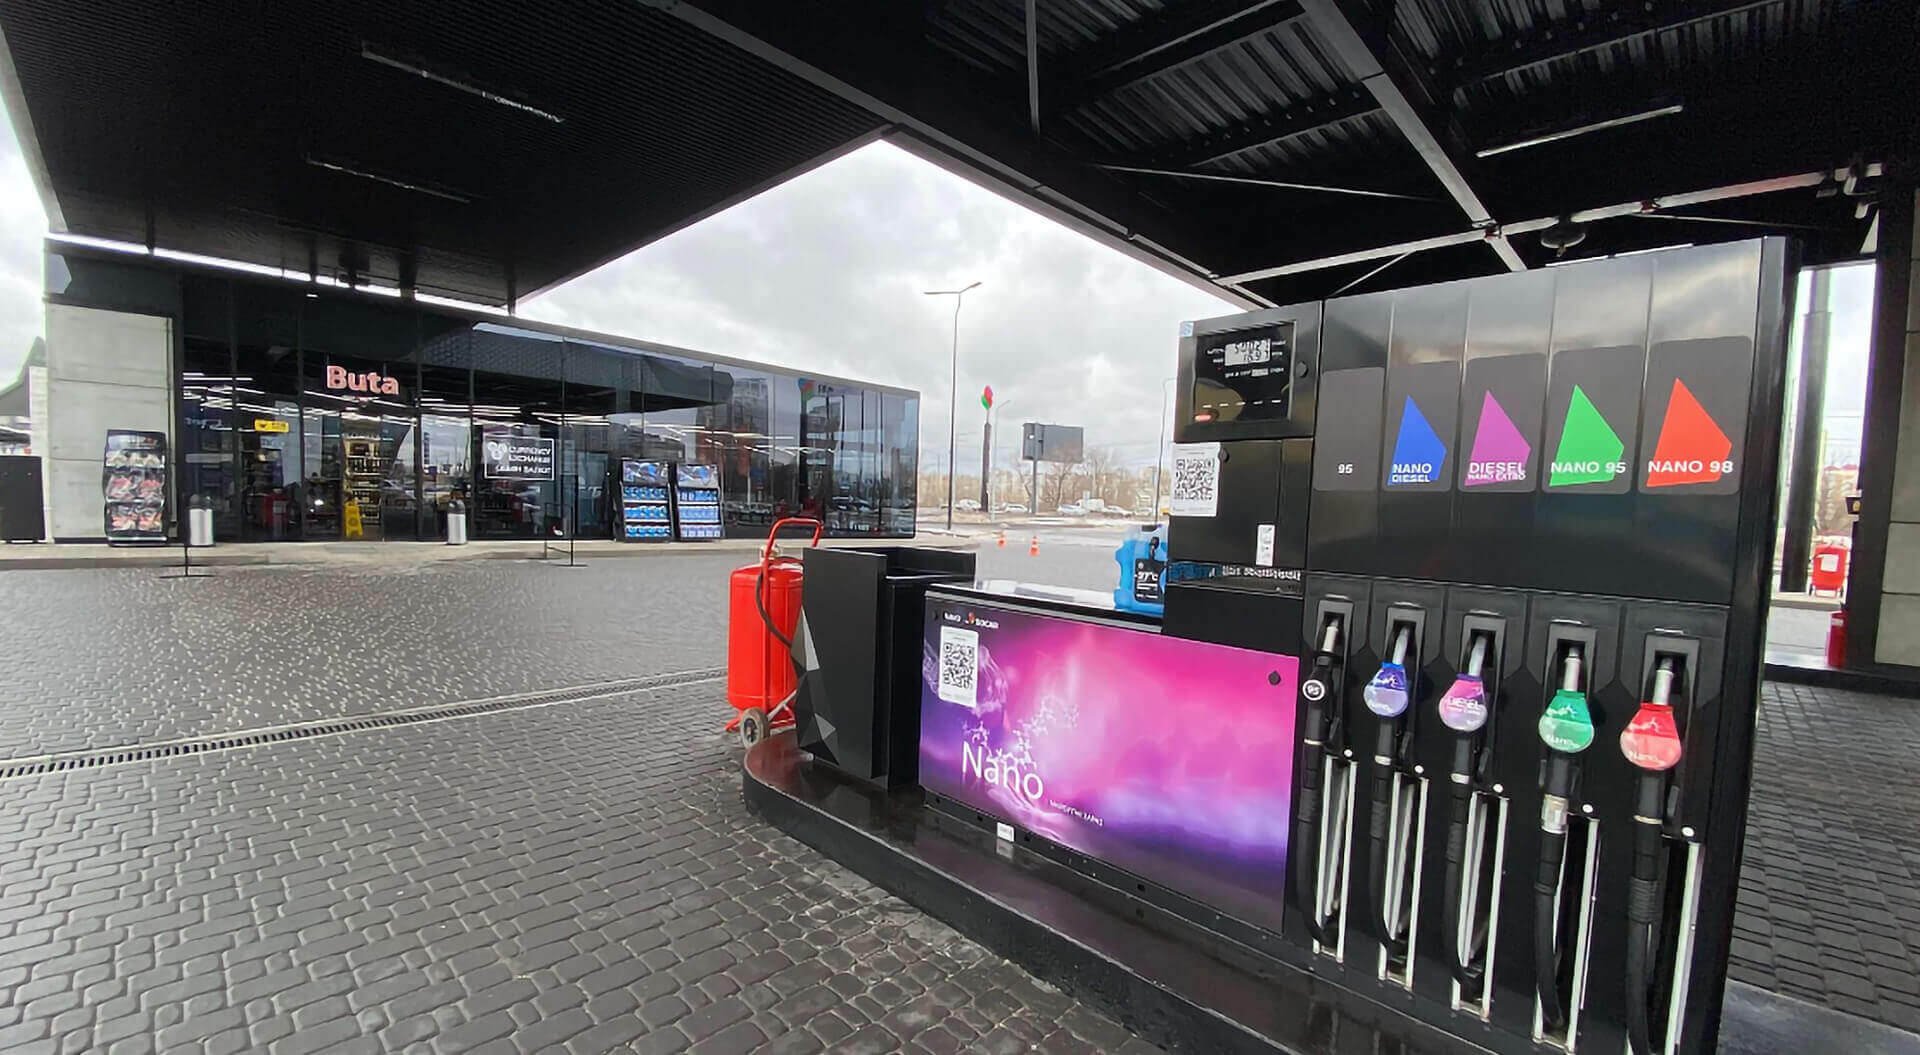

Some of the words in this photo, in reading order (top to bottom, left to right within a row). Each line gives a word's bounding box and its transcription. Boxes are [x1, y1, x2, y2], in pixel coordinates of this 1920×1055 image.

[326, 365, 399, 395] Buta
[1337, 463, 1353, 474] 95
[1392, 463, 1432, 474] NANO
[1468, 462, 1526, 474] DIESEL
[1551, 461, 1600, 474] NANO
[1605, 461, 1627, 474] 95
[1647, 460, 1703, 473] NANO
[1709, 460, 1734, 473] 98
[1391, 474, 1431, 483] DIESEL
[962, 741, 1044, 800] Nano
